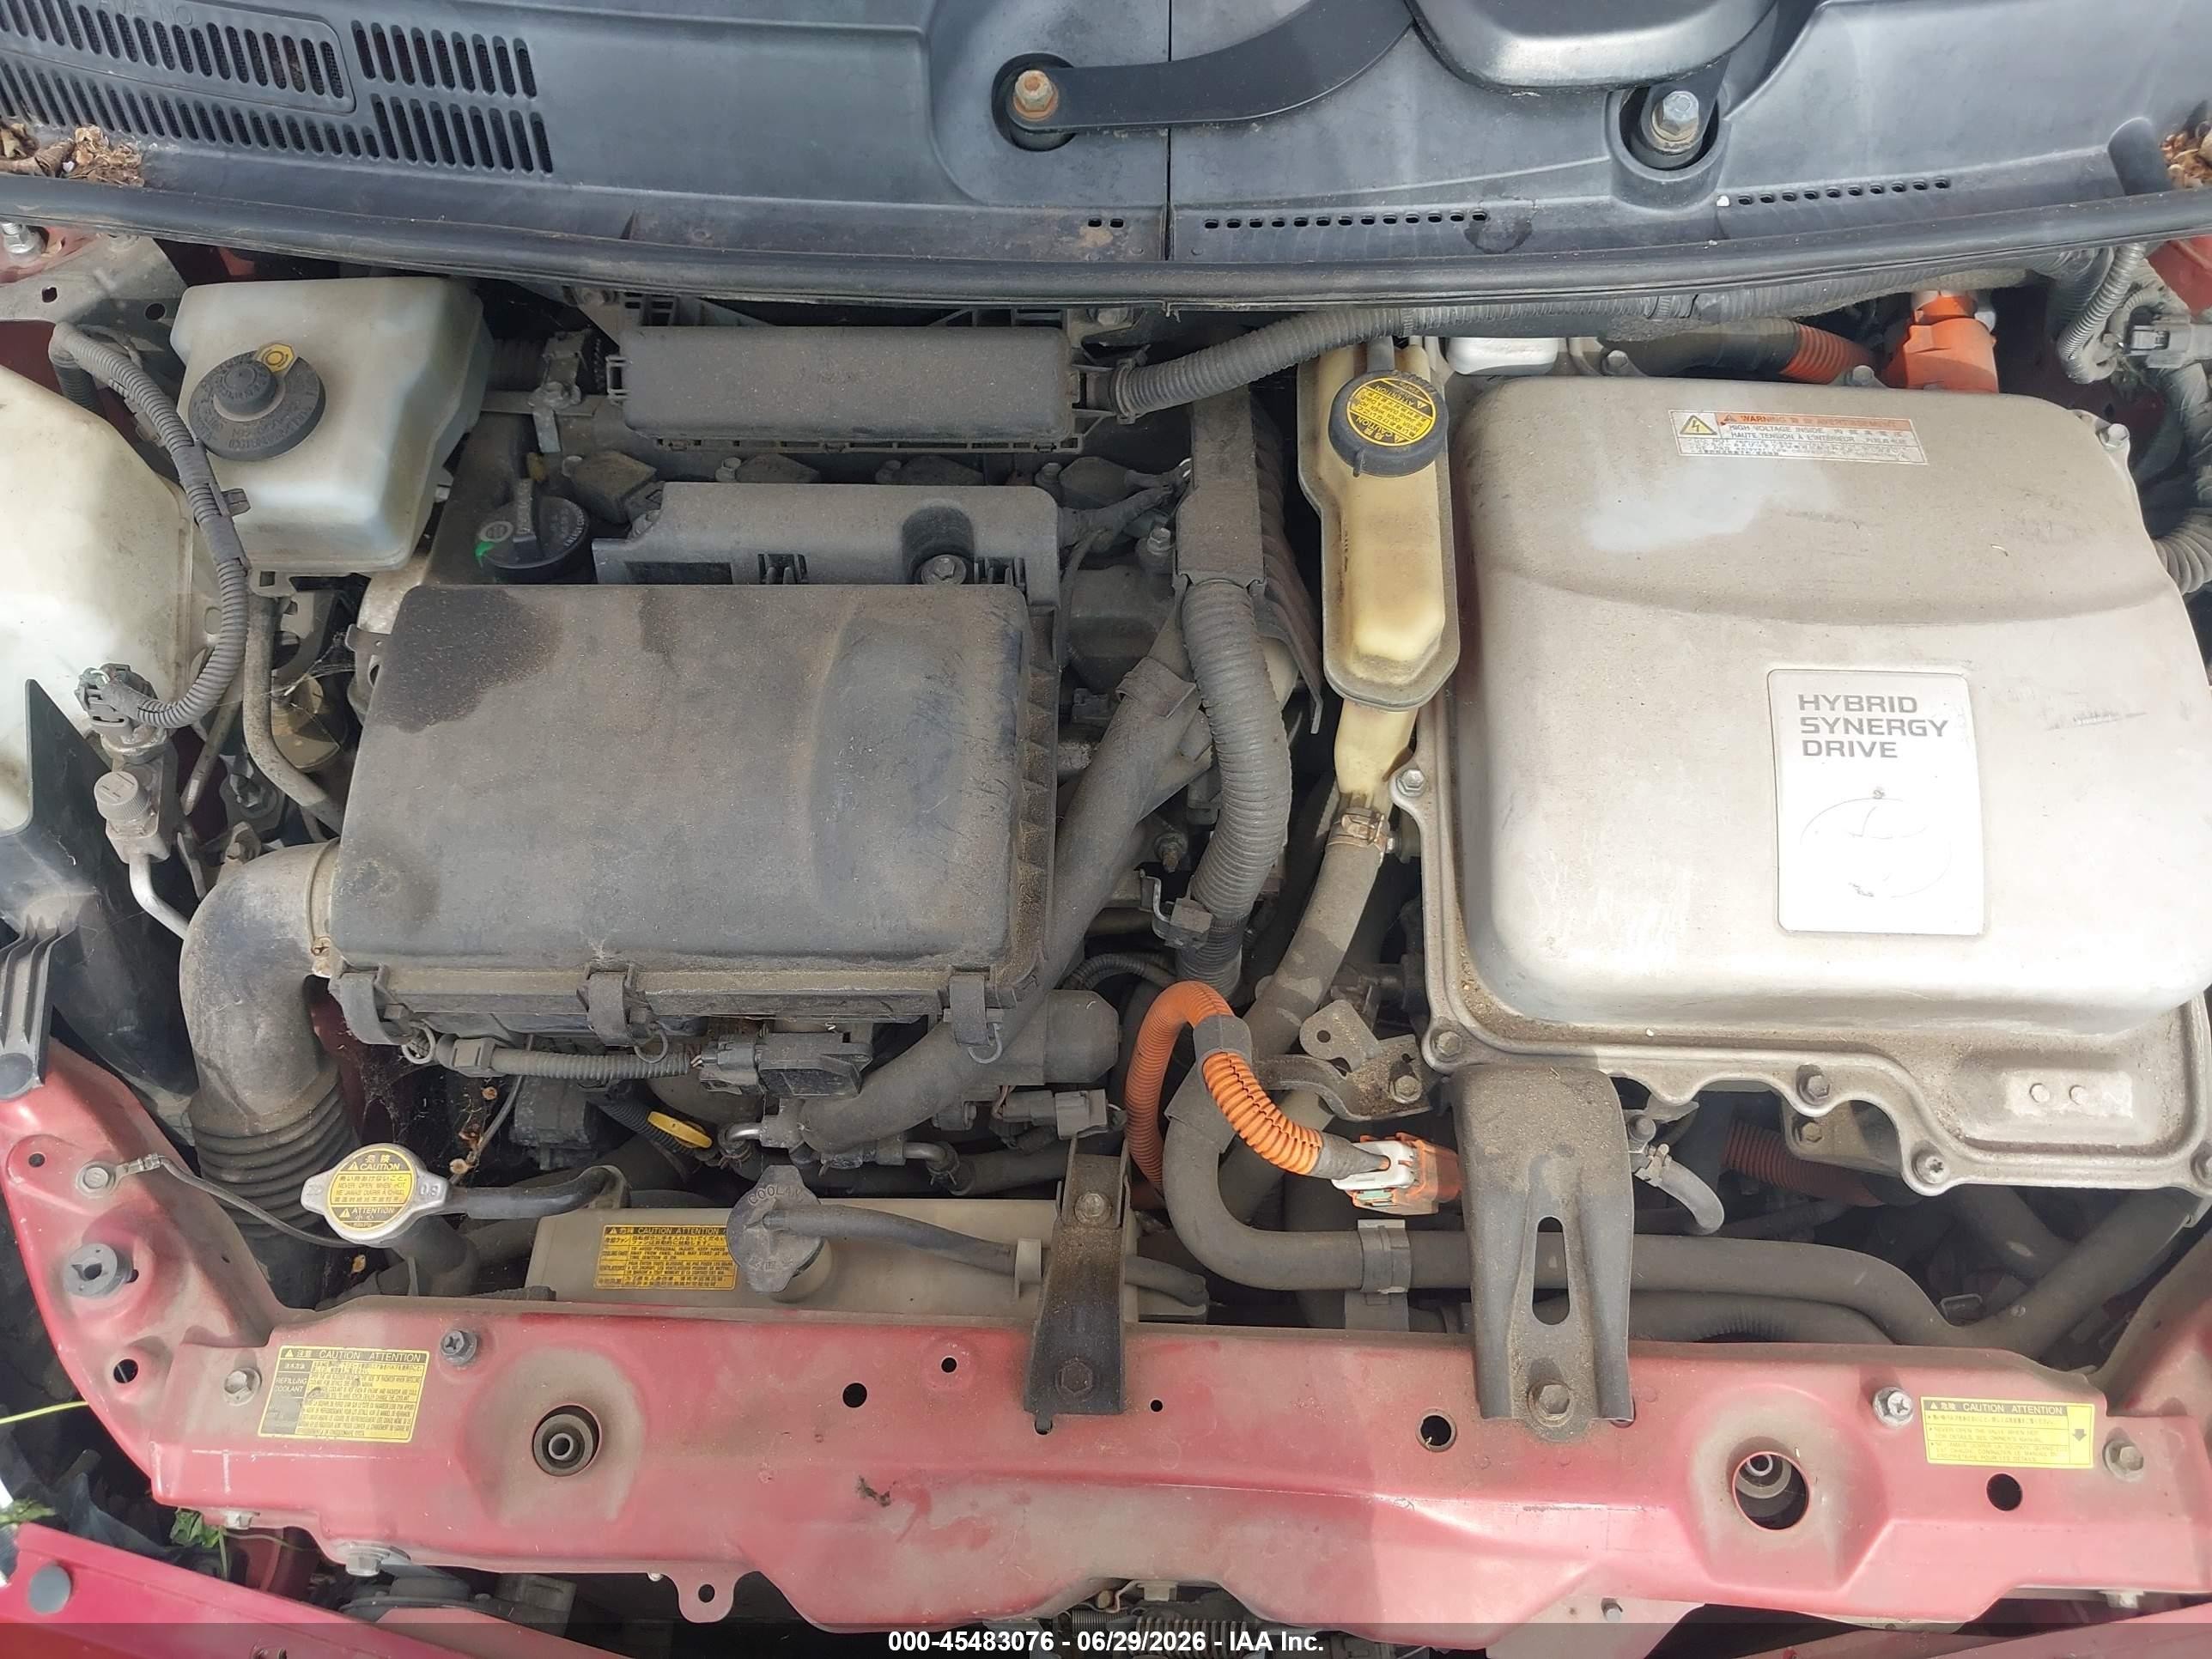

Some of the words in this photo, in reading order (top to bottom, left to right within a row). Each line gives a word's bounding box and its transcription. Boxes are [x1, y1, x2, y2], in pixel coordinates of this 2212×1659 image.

[1798, 694, 1917, 713] HYBRID
[1800, 717, 1948, 737] SYNERGY
[1802, 740, 1898, 758] DRIVE
[319, 1350, 361, 1360] CAUTION
[369, 1352, 422, 1362] ATTENTION
[1963, 1403, 2004, 1413] CAUTION
[2011, 1405, 2063, 1415] ATTENTION
